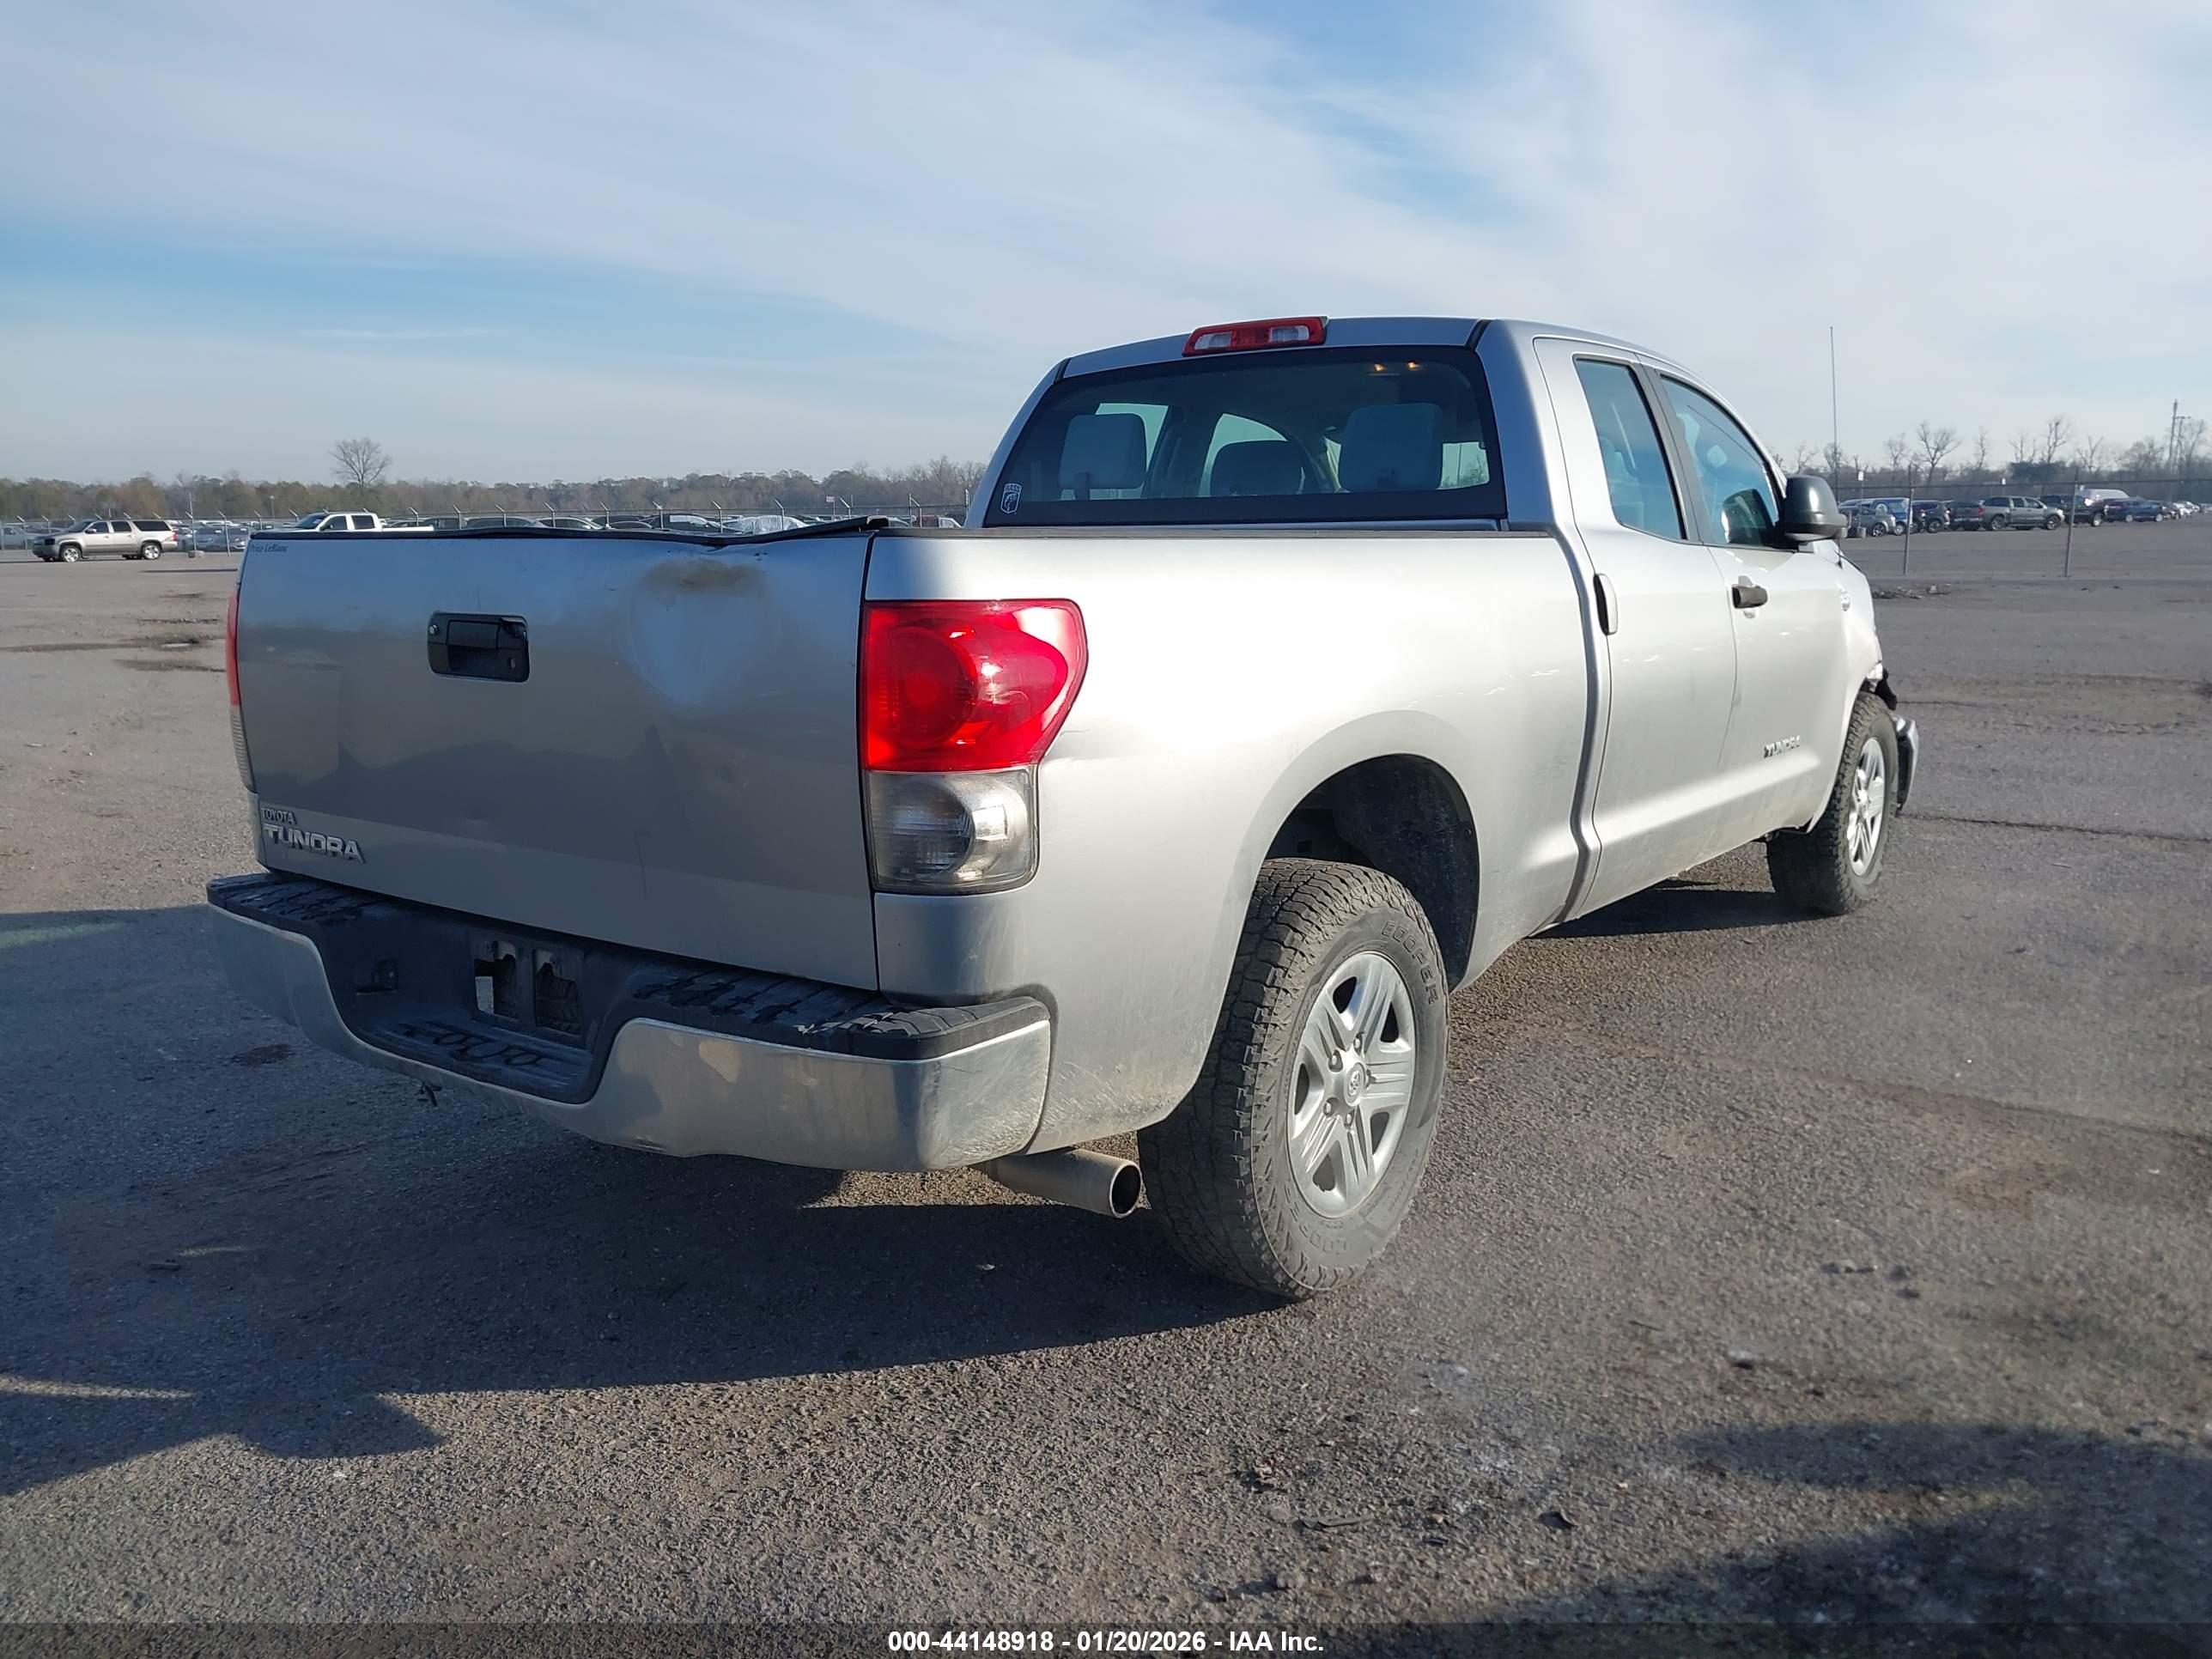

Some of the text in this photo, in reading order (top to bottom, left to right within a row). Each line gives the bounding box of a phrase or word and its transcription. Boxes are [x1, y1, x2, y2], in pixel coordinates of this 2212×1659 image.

[262, 807, 297, 824] TOYOTA
[263, 823, 367, 864] TUNDRA
[1381, 921, 1439, 1005] COOPER
